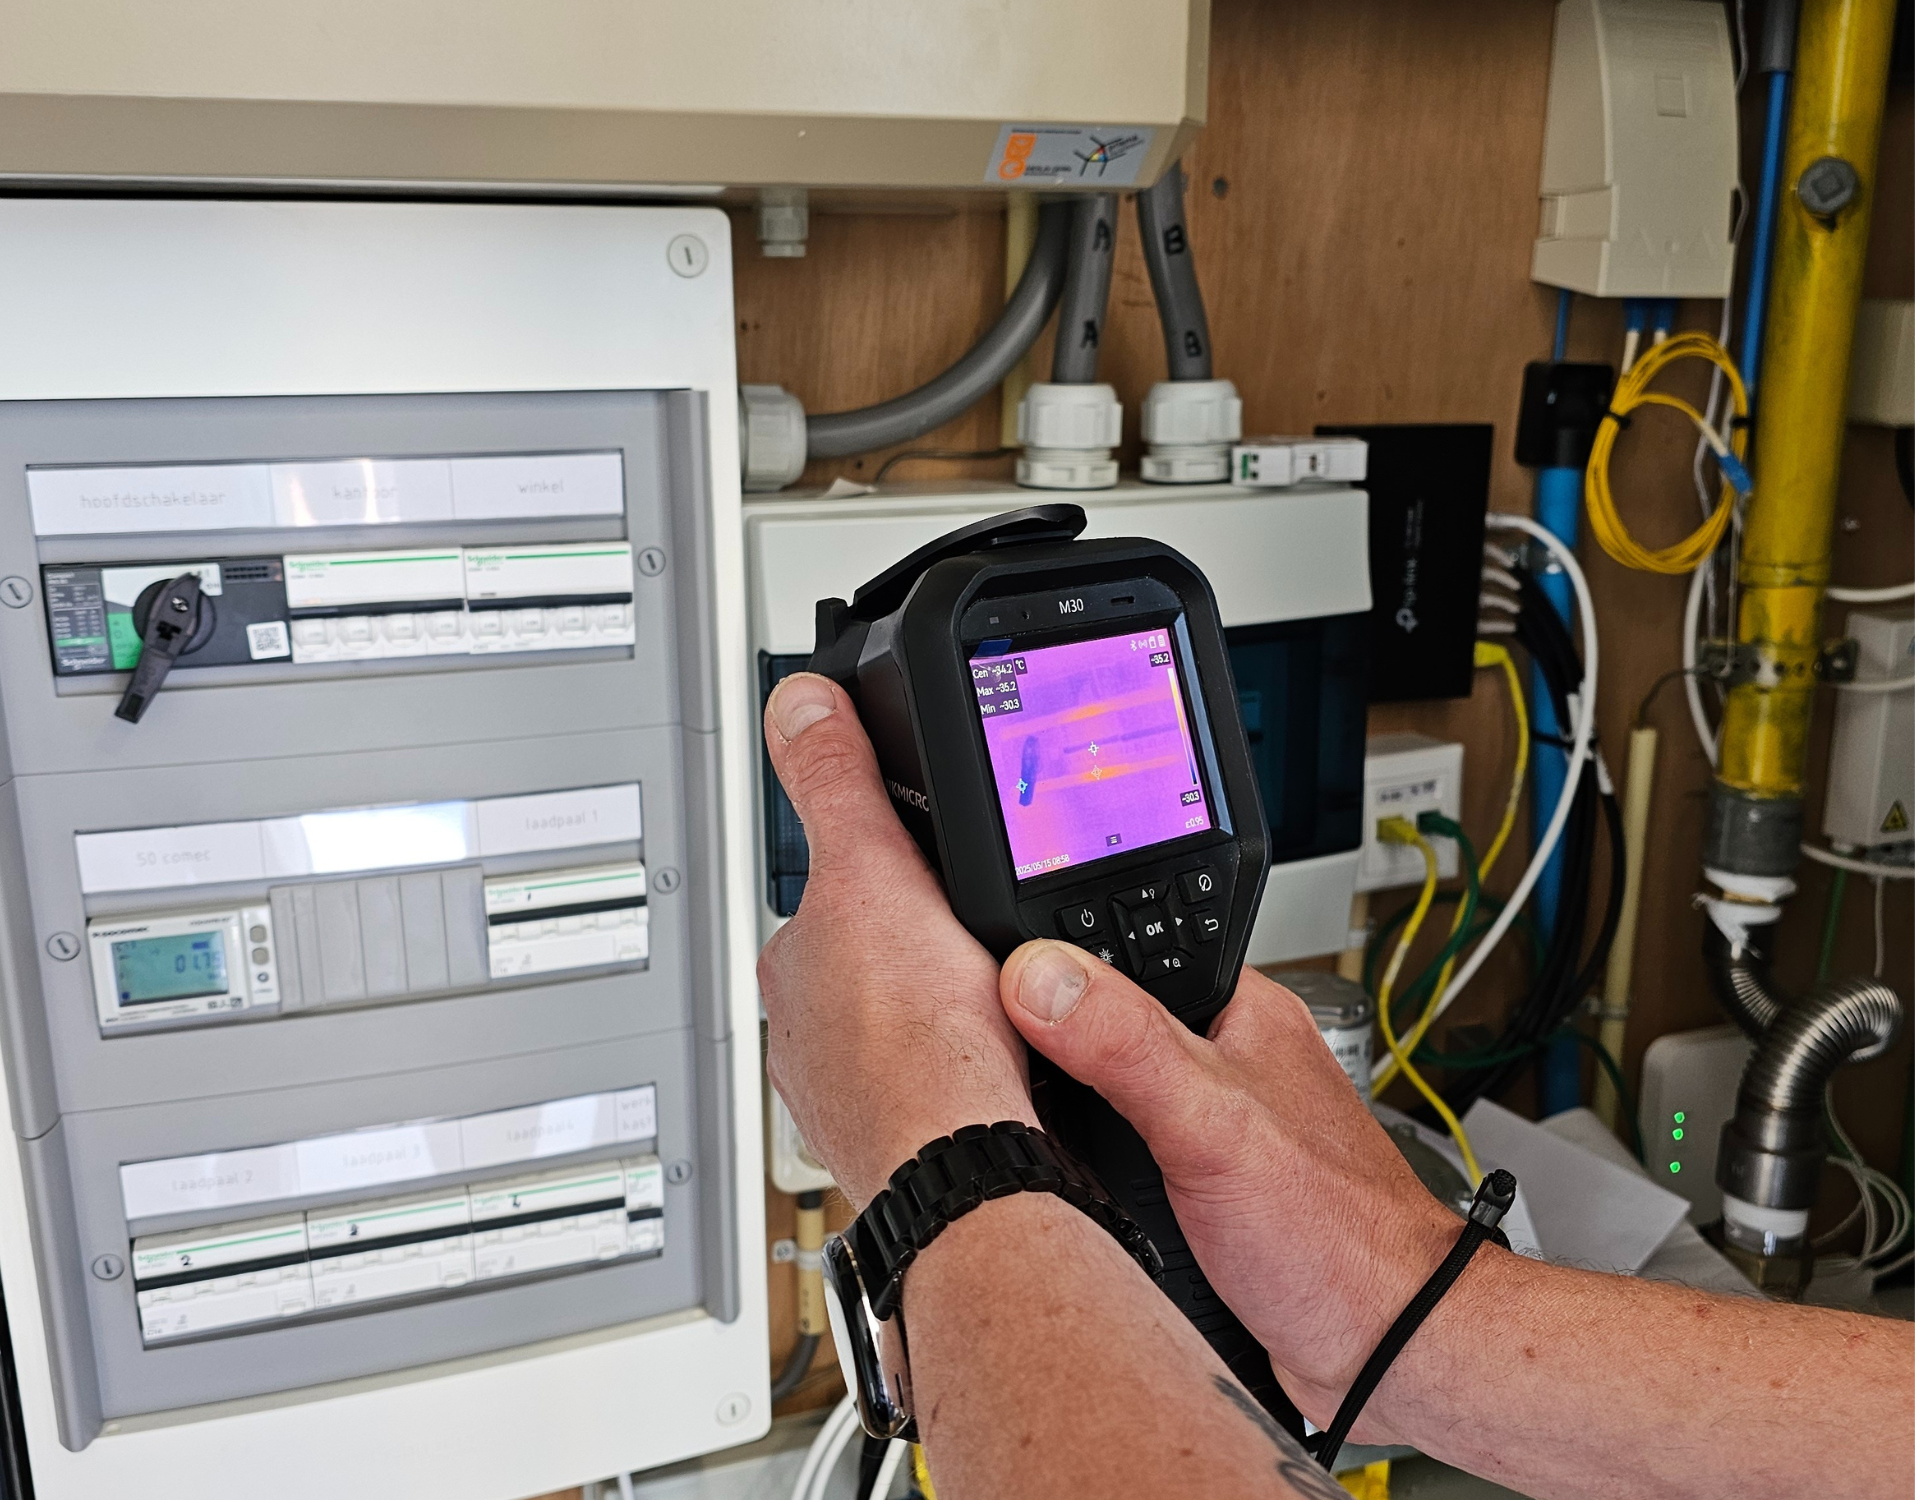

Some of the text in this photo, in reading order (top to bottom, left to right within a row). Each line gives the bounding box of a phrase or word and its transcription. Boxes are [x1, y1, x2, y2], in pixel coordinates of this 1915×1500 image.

[1093, 218, 1111, 251] A
[1164, 224, 1185, 256] B
[1080, 319, 1098, 349] A
[1184, 329, 1200, 357] B
[331, 484, 400, 501] kanoor
[517, 478, 565, 494] winkel
[79, 490, 226, 509] hoofdschakelaar
[1058, 598, 1084, 614] M30
[972, 668, 989, 679] Cen
[976, 686, 994, 697] Max
[980, 703, 996, 715] Min
[525, 810, 586, 832] laadpaal
[1015, 858, 1052, 876] 2025/05/15
[1145, 921, 1164, 936] OK
[180, 1253, 193, 1267] 2
